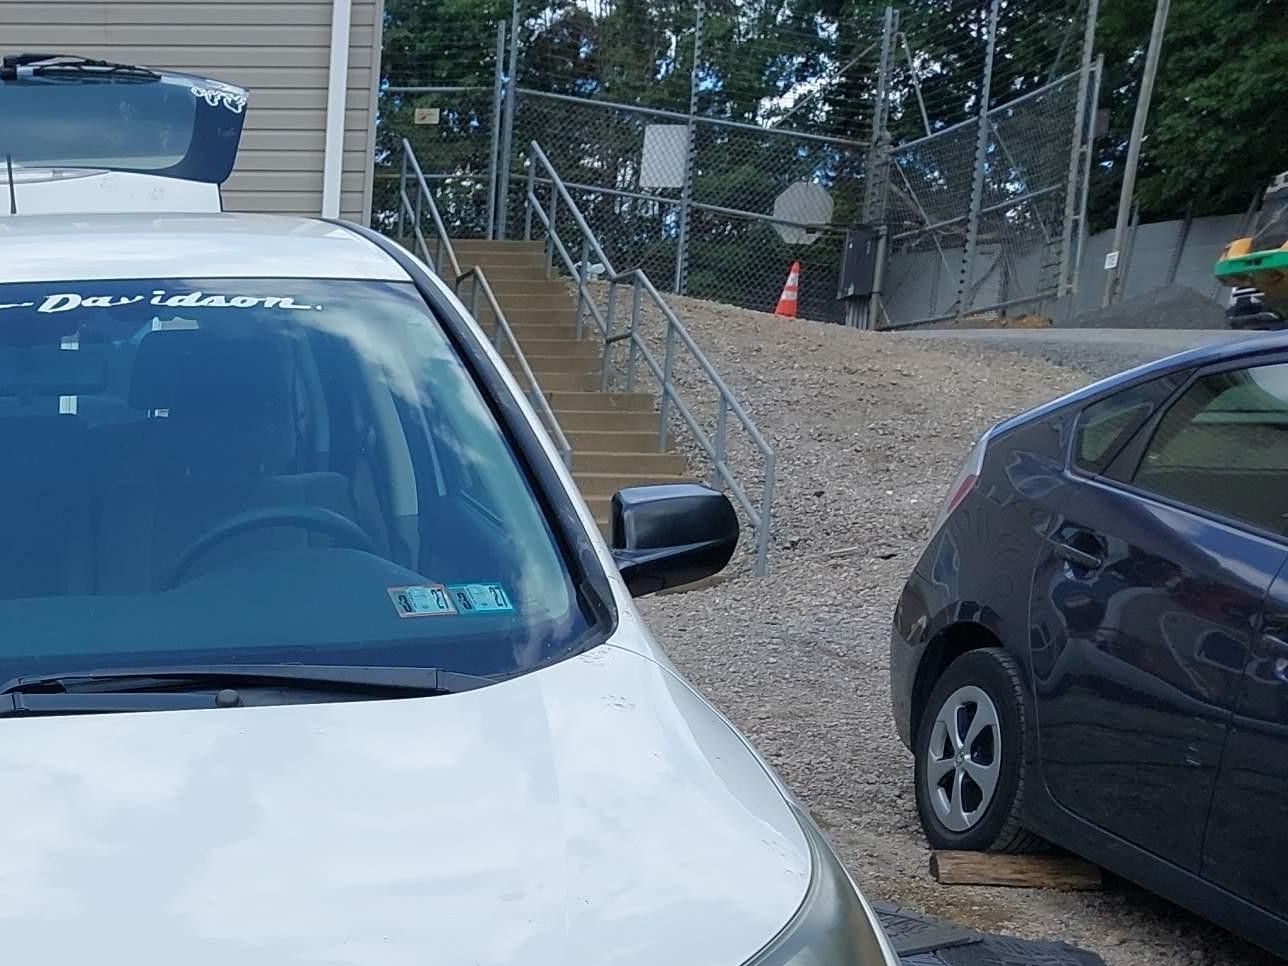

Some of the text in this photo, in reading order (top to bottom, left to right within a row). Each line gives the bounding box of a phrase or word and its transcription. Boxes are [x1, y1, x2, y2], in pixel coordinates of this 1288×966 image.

[398, 594, 413, 613] 3
[430, 588, 449, 609] 27
[456, 592, 473, 610] 3
[488, 586, 508, 608] 27
